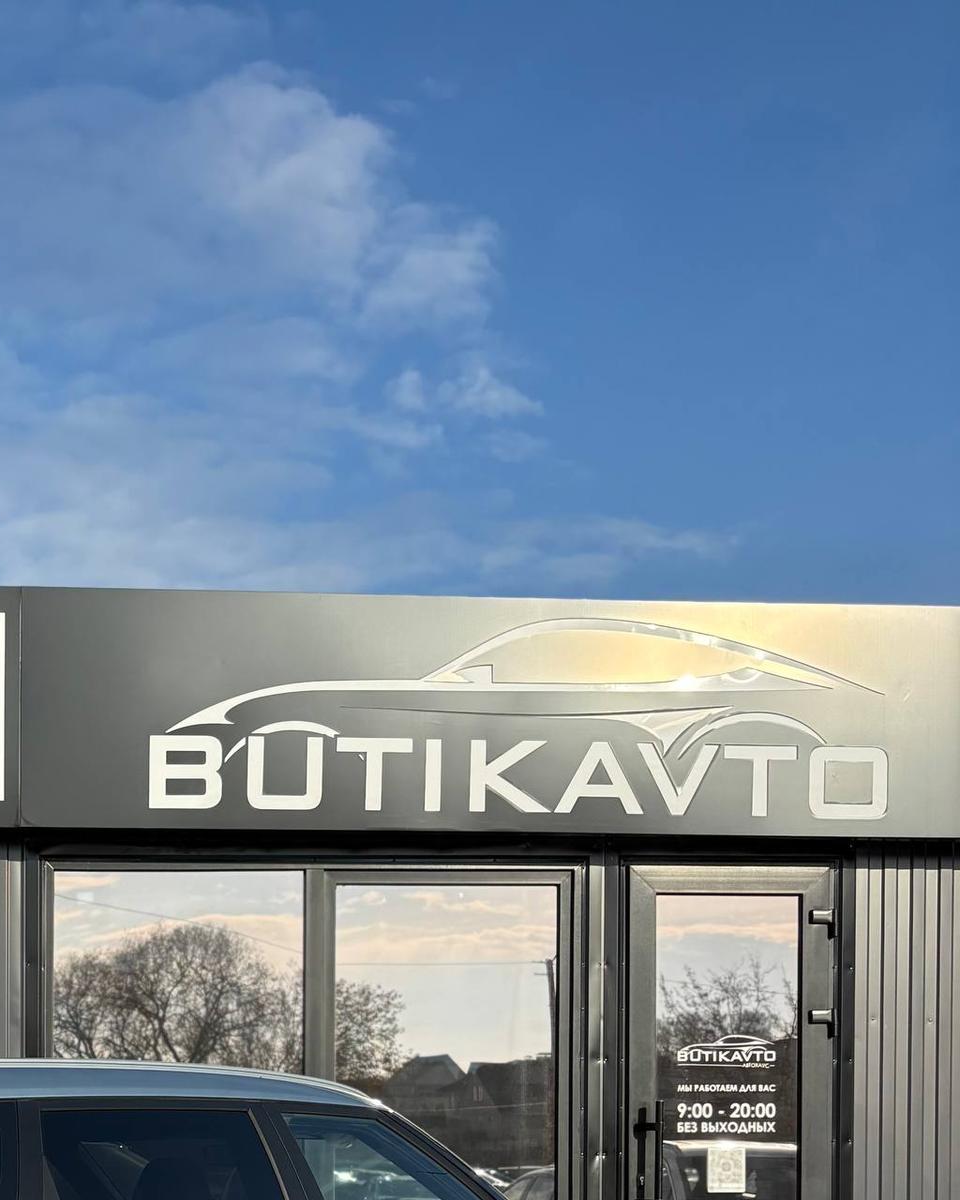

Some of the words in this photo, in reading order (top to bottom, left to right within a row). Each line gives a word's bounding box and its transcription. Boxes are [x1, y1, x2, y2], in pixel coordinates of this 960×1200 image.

[149, 733, 889, 819] BUTIKAVTO
[677, 1050, 776, 1062] BUTIKAVTO
[677, 1084, 692, 1093] МЫ
[694, 1084, 738, 1093] РАБОТАЕМ
[738, 1084, 757, 1093] ДЛЯ
[758, 1084, 776, 1092] ВАС
[677, 1103, 713, 1118] 9:00
[729, 1103, 776, 1118] 20:00
[677, 1122, 698, 1133] БЕЗ
[701, 1122, 776, 1134] ВЫХОДНЫХ
